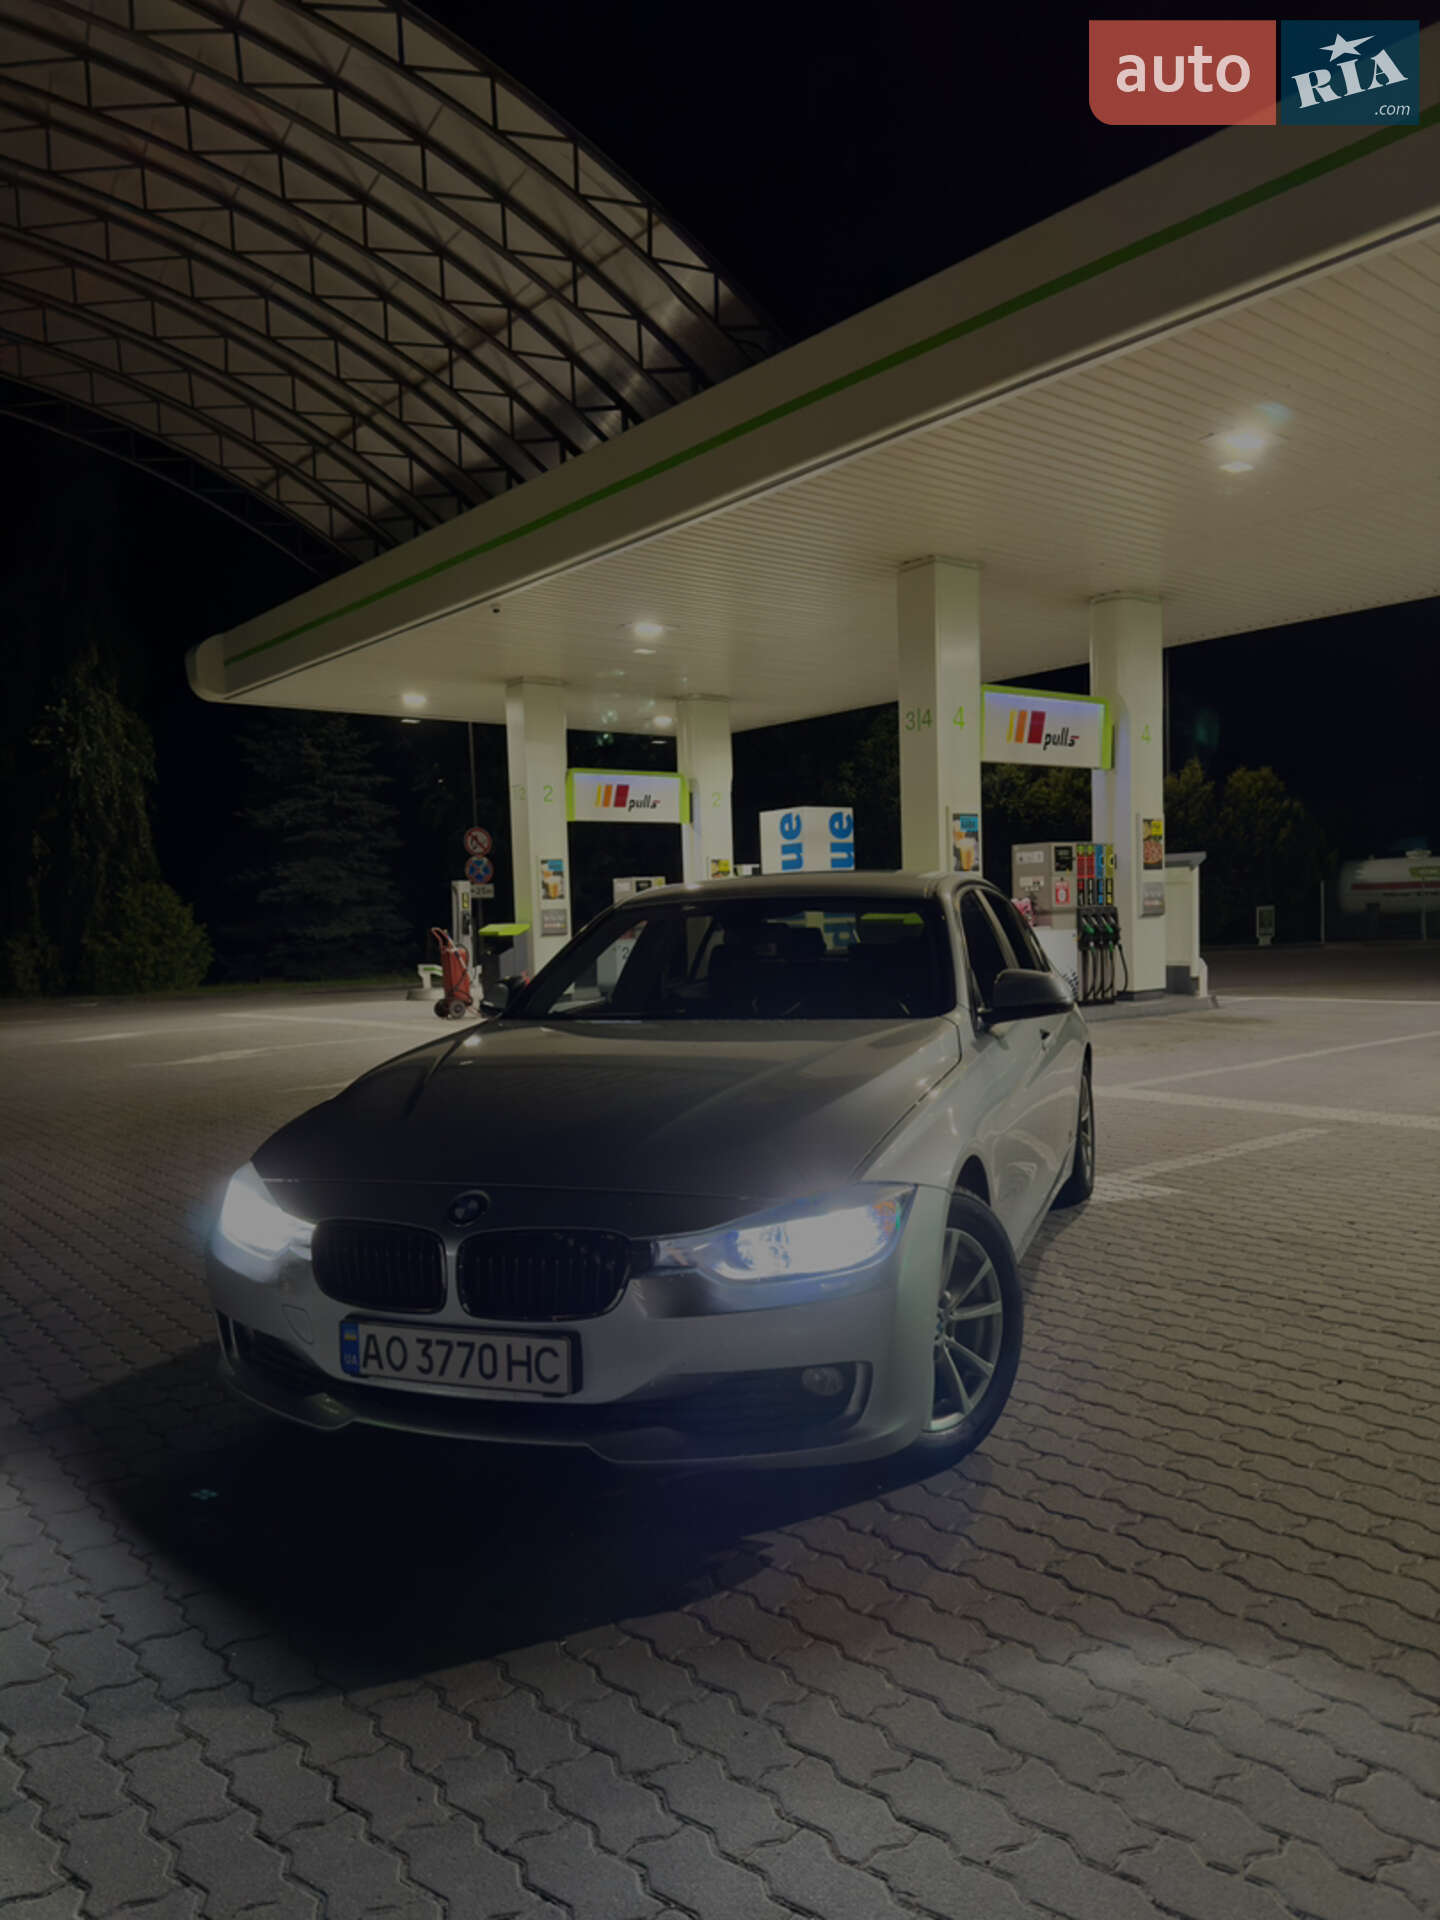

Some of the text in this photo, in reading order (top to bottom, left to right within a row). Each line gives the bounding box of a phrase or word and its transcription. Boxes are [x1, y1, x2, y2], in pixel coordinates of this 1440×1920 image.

[953, 706, 965, 731] 4
[1043, 727, 1080, 750] pulls
[543, 785, 553, 802] 2
[628, 795, 661, 812] pulls
[362, 1334, 560, 1384] AO 3770 HC
